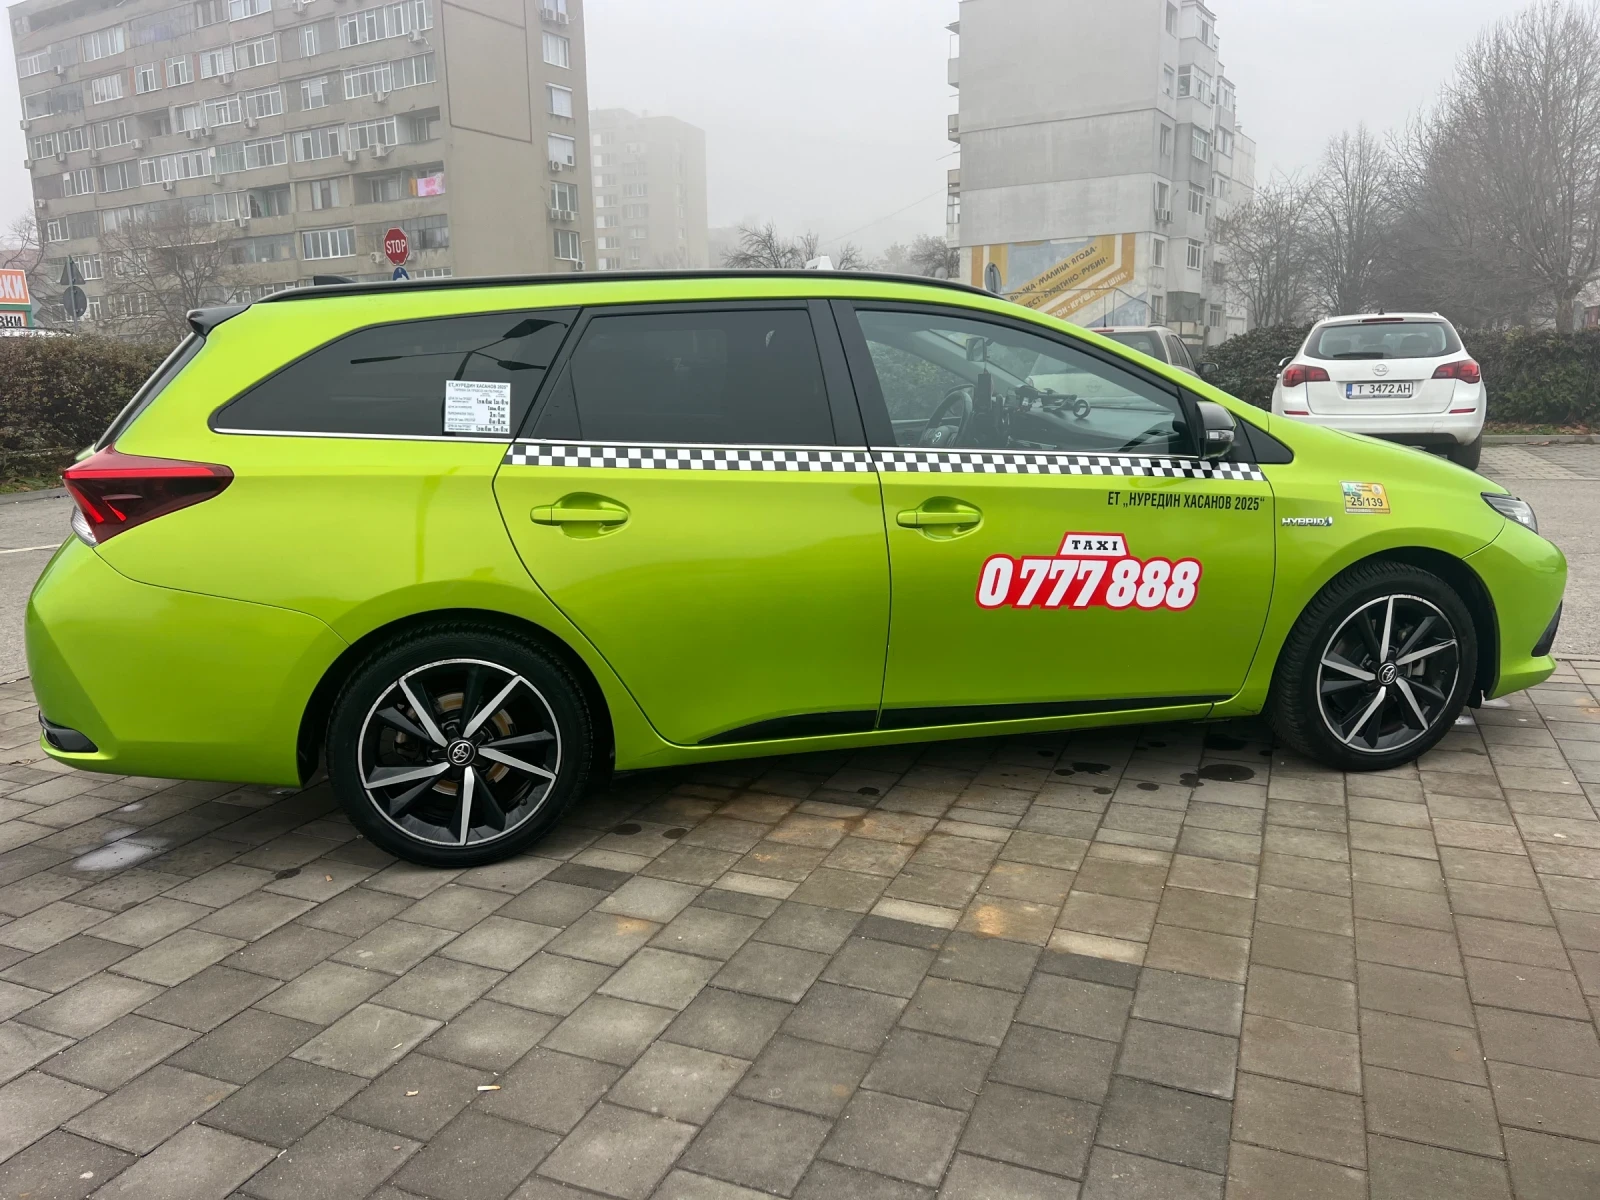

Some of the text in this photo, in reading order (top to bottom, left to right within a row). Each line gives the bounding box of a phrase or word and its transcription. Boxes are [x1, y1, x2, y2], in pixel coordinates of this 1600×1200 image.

[386, 239, 406, 254] STOP
[1038, 263, 1069, 286] МАЛИНА
[1071, 246, 1096, 265] ЯГОДА
[1081, 257, 1106, 275] РУБИН
[1070, 290, 1096, 309] КРУША
[1357, 383, 1411, 394] T 3472 AH
[1107, 491, 1120, 506] ЕТ
[1183, 494, 1232, 510] ХАСАНОВ
[1282, 517, 1325, 526] HYBRID
[1071, 539, 1119, 551] TAXI
